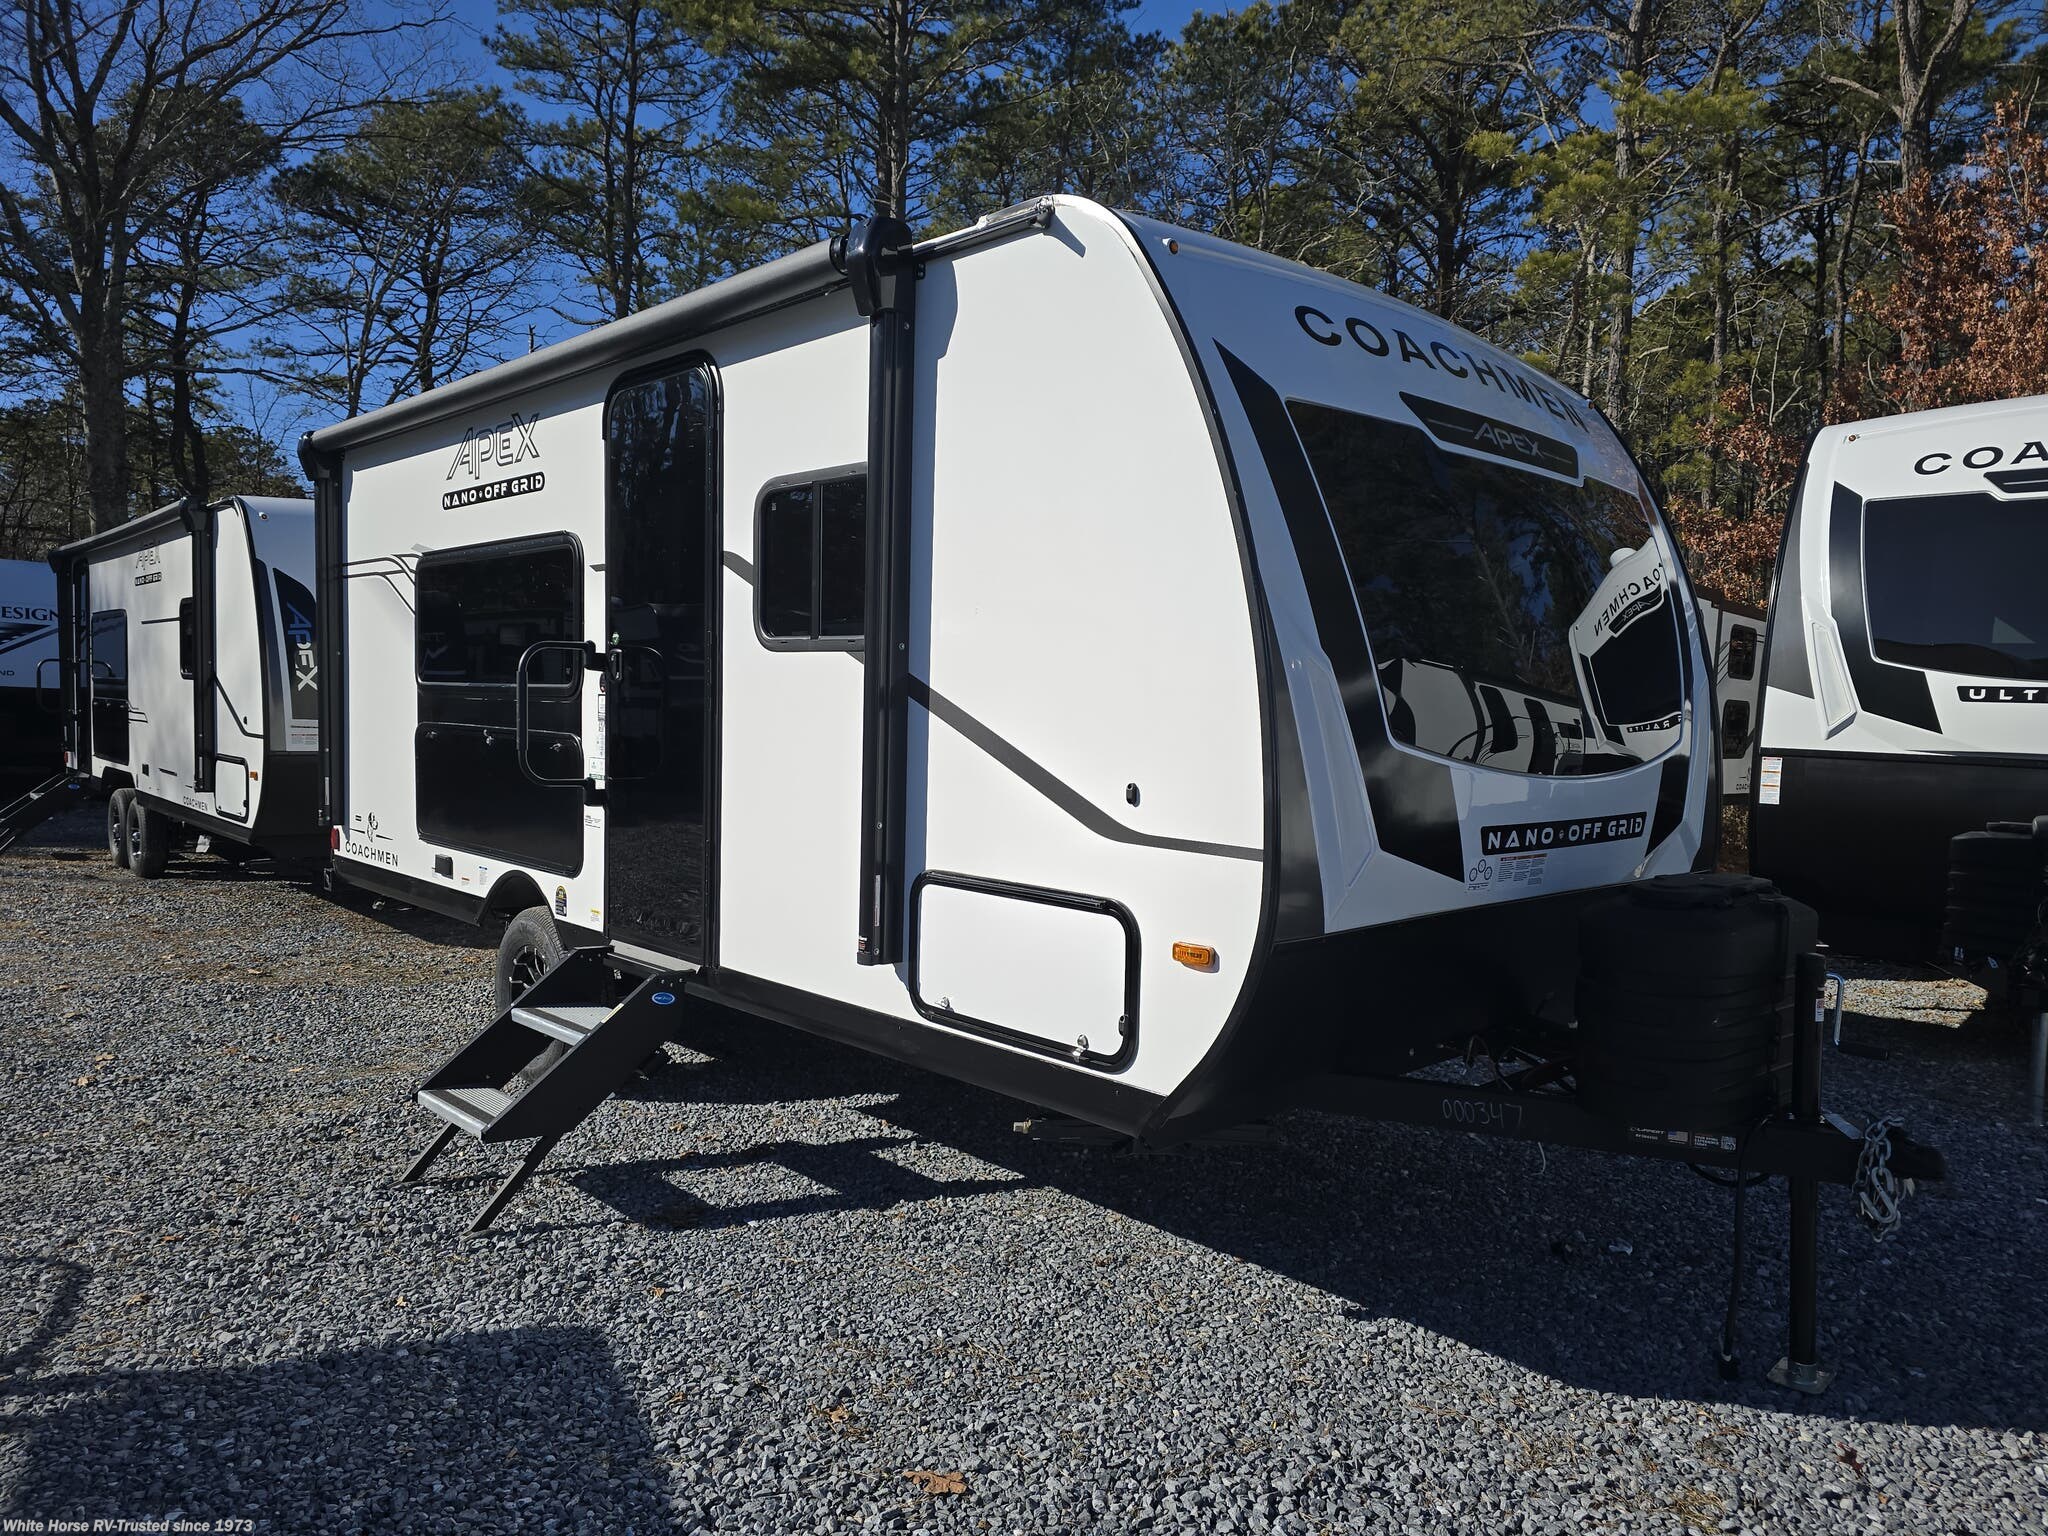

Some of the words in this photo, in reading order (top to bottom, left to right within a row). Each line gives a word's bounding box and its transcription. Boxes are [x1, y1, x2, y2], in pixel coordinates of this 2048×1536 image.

[1294, 305, 1591, 434] COACHMEN
[446, 412, 540, 480] APEX
[1473, 422, 1544, 458] APEX
[1913, 440, 2048, 476] COA
[444, 491, 478, 508] NANO
[484, 482, 508, 498] OFF
[511, 475, 544, 493] GRID
[286, 601, 319, 692] APEX
[1968, 688, 2040, 702] ULT
[1487, 827, 1555, 850] NANO
[1568, 822, 1603, 842] OFF
[1607, 817, 1643, 837] GRID
[344, 840, 399, 867] COACHMEN
